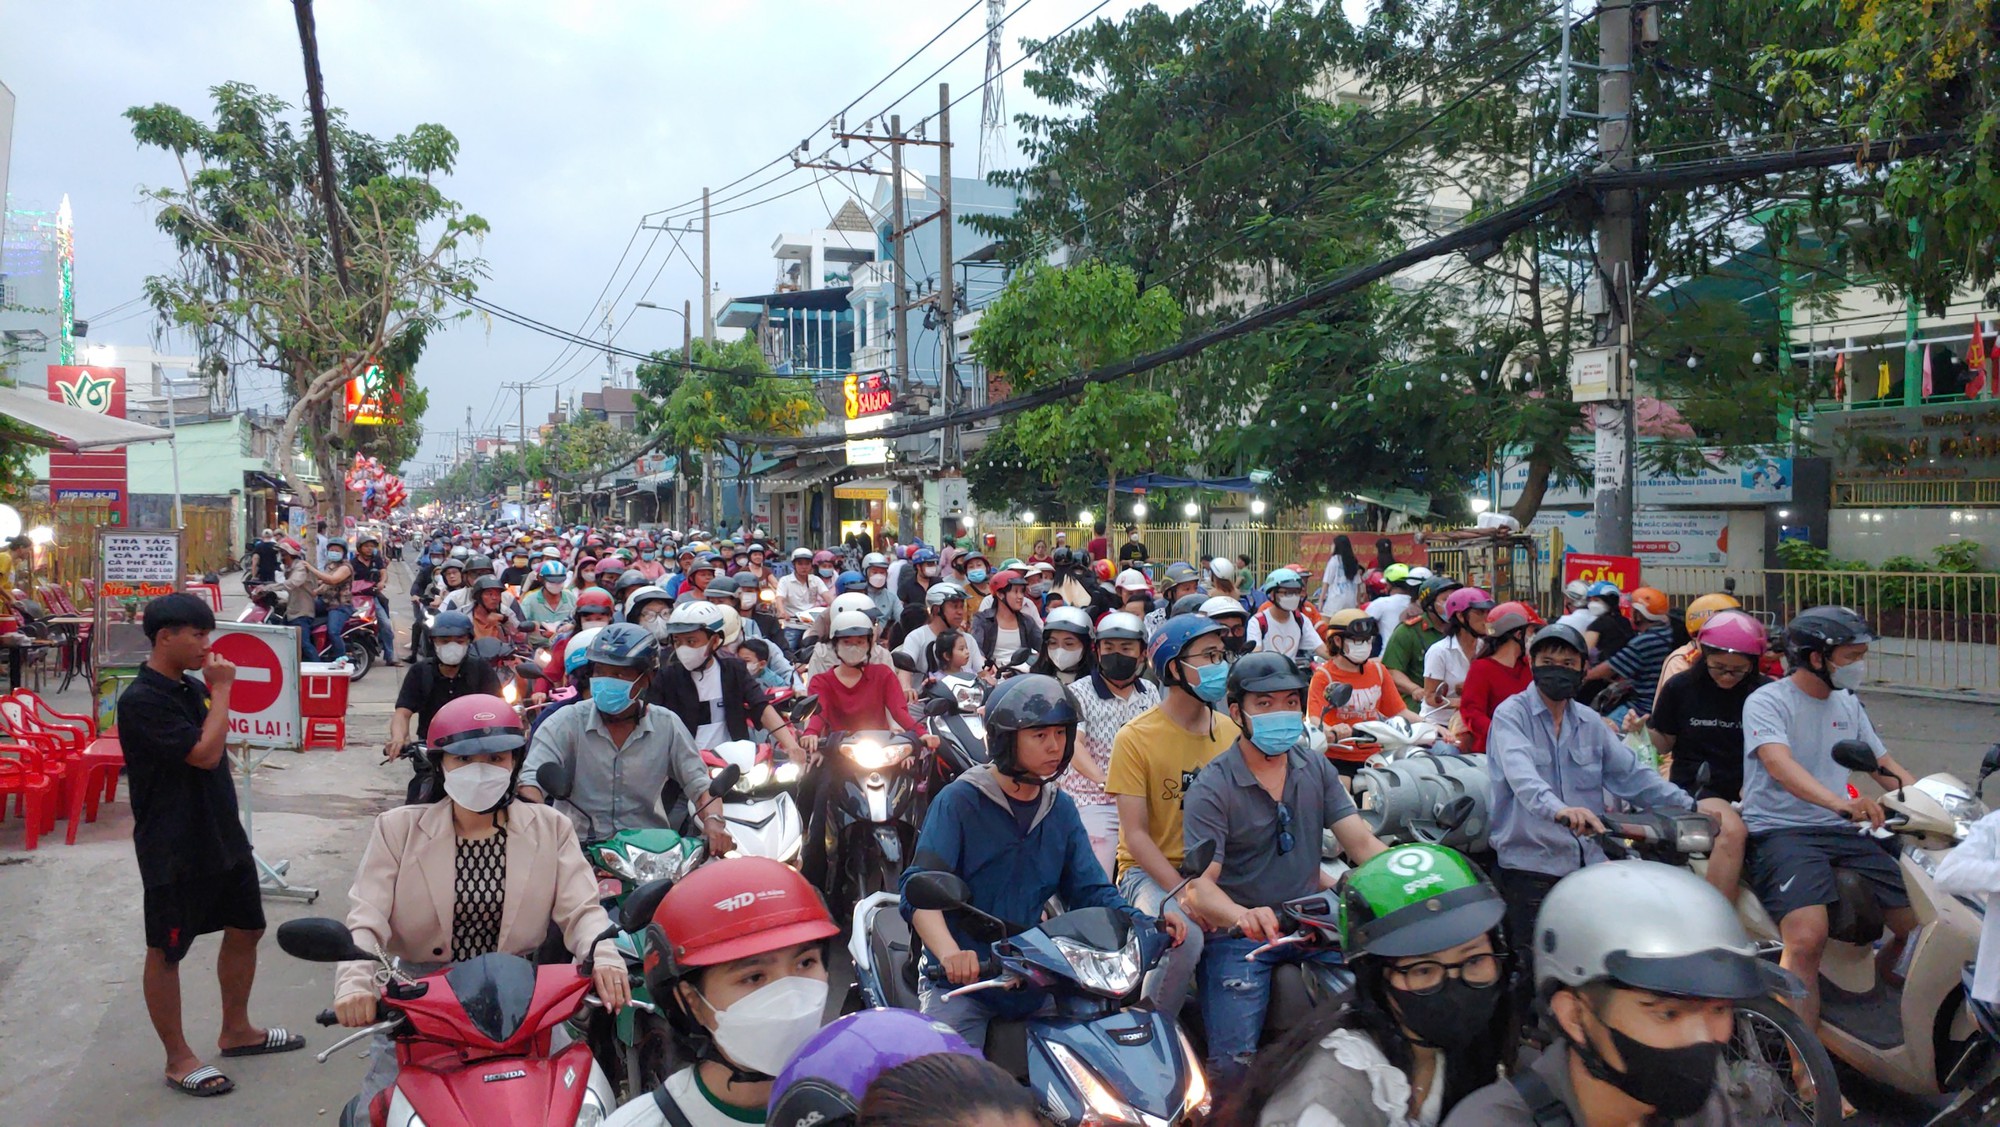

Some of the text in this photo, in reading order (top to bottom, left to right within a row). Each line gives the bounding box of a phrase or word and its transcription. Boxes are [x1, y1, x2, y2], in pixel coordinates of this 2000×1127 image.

[1689, 716, 1718, 727] Spread
[255, 719, 281, 740] LẠI
[483, 1069, 527, 1082] HONDA
